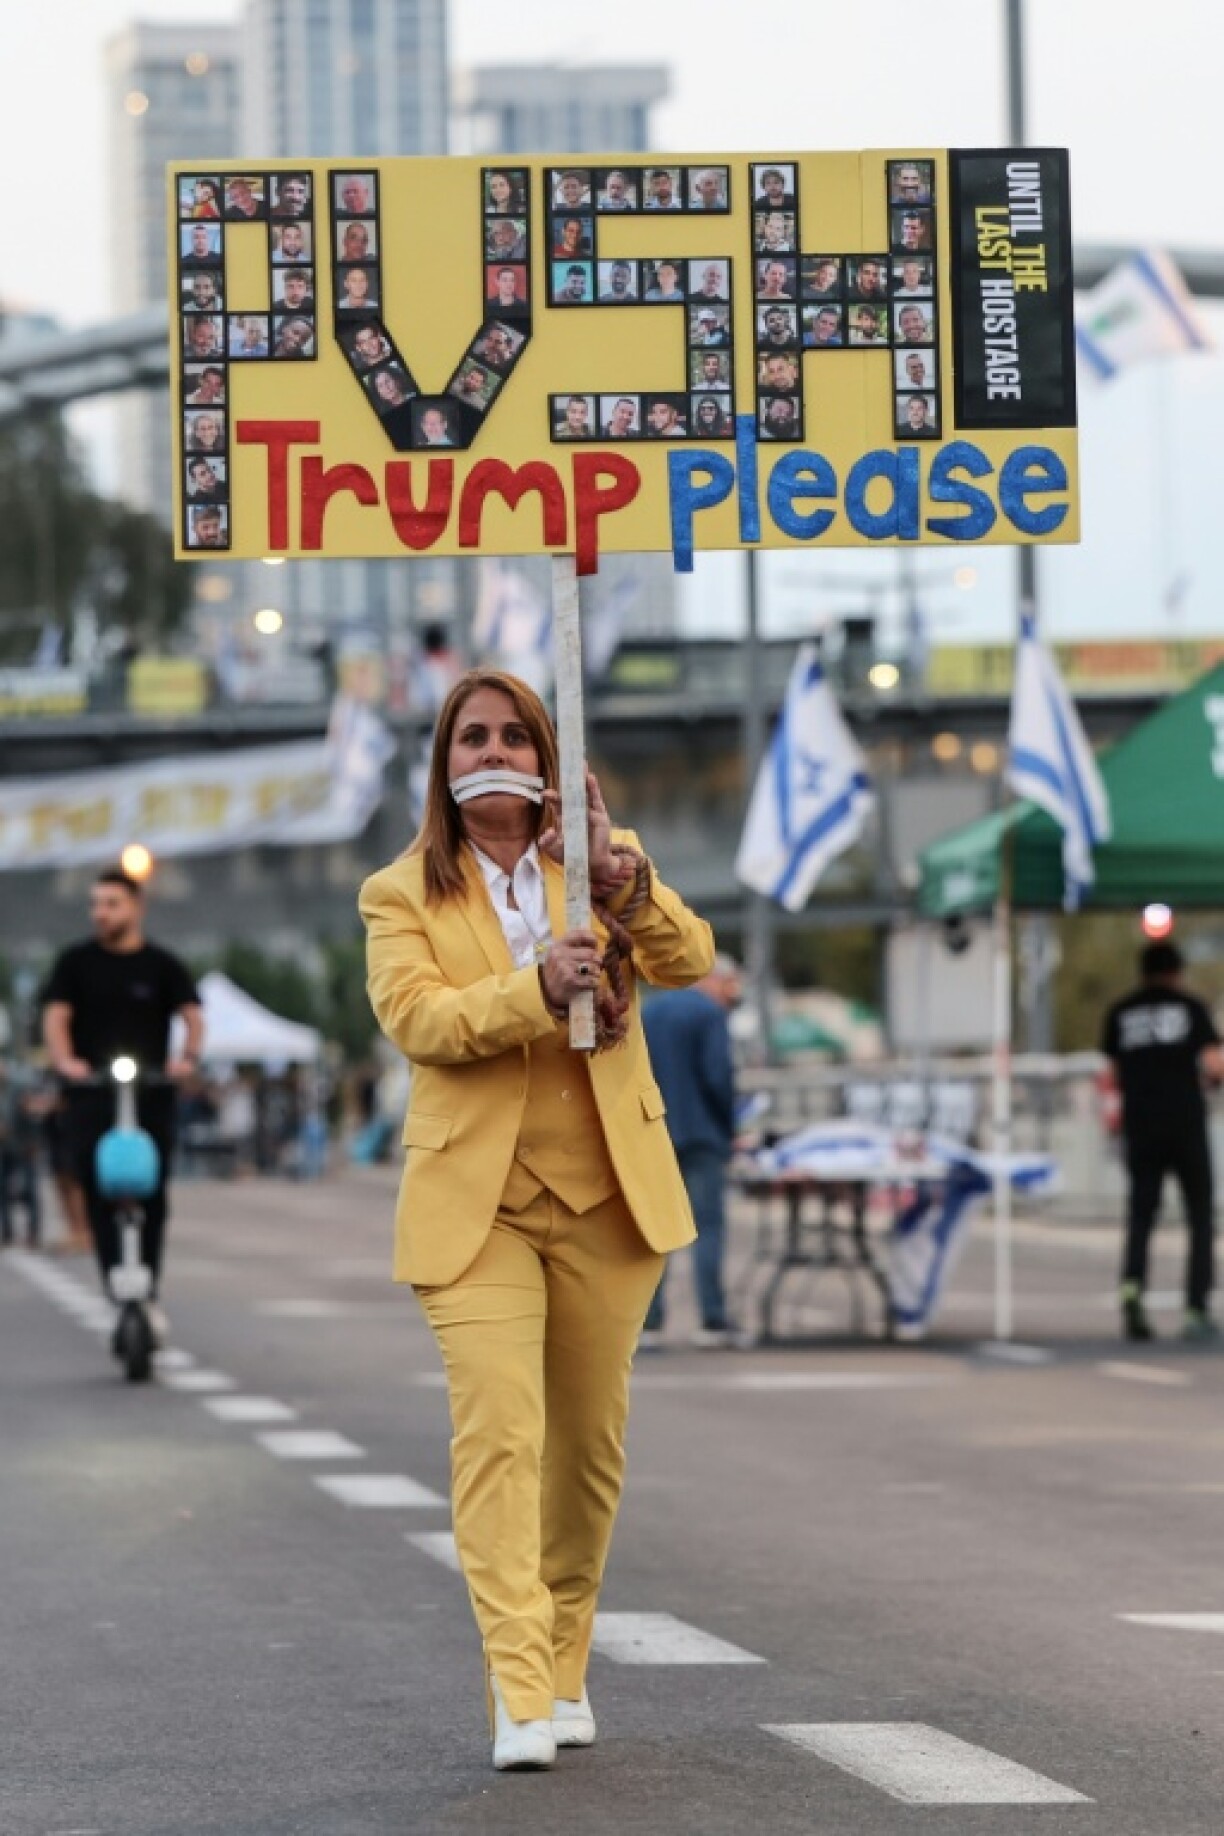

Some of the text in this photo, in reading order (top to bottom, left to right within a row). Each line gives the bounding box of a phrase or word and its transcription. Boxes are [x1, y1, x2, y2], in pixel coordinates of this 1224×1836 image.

[975, 206, 1021, 400] LAST HOSTAGE
[1006, 162, 1047, 292] UNTIL THE
[236, 414, 1069, 576] Trump please
